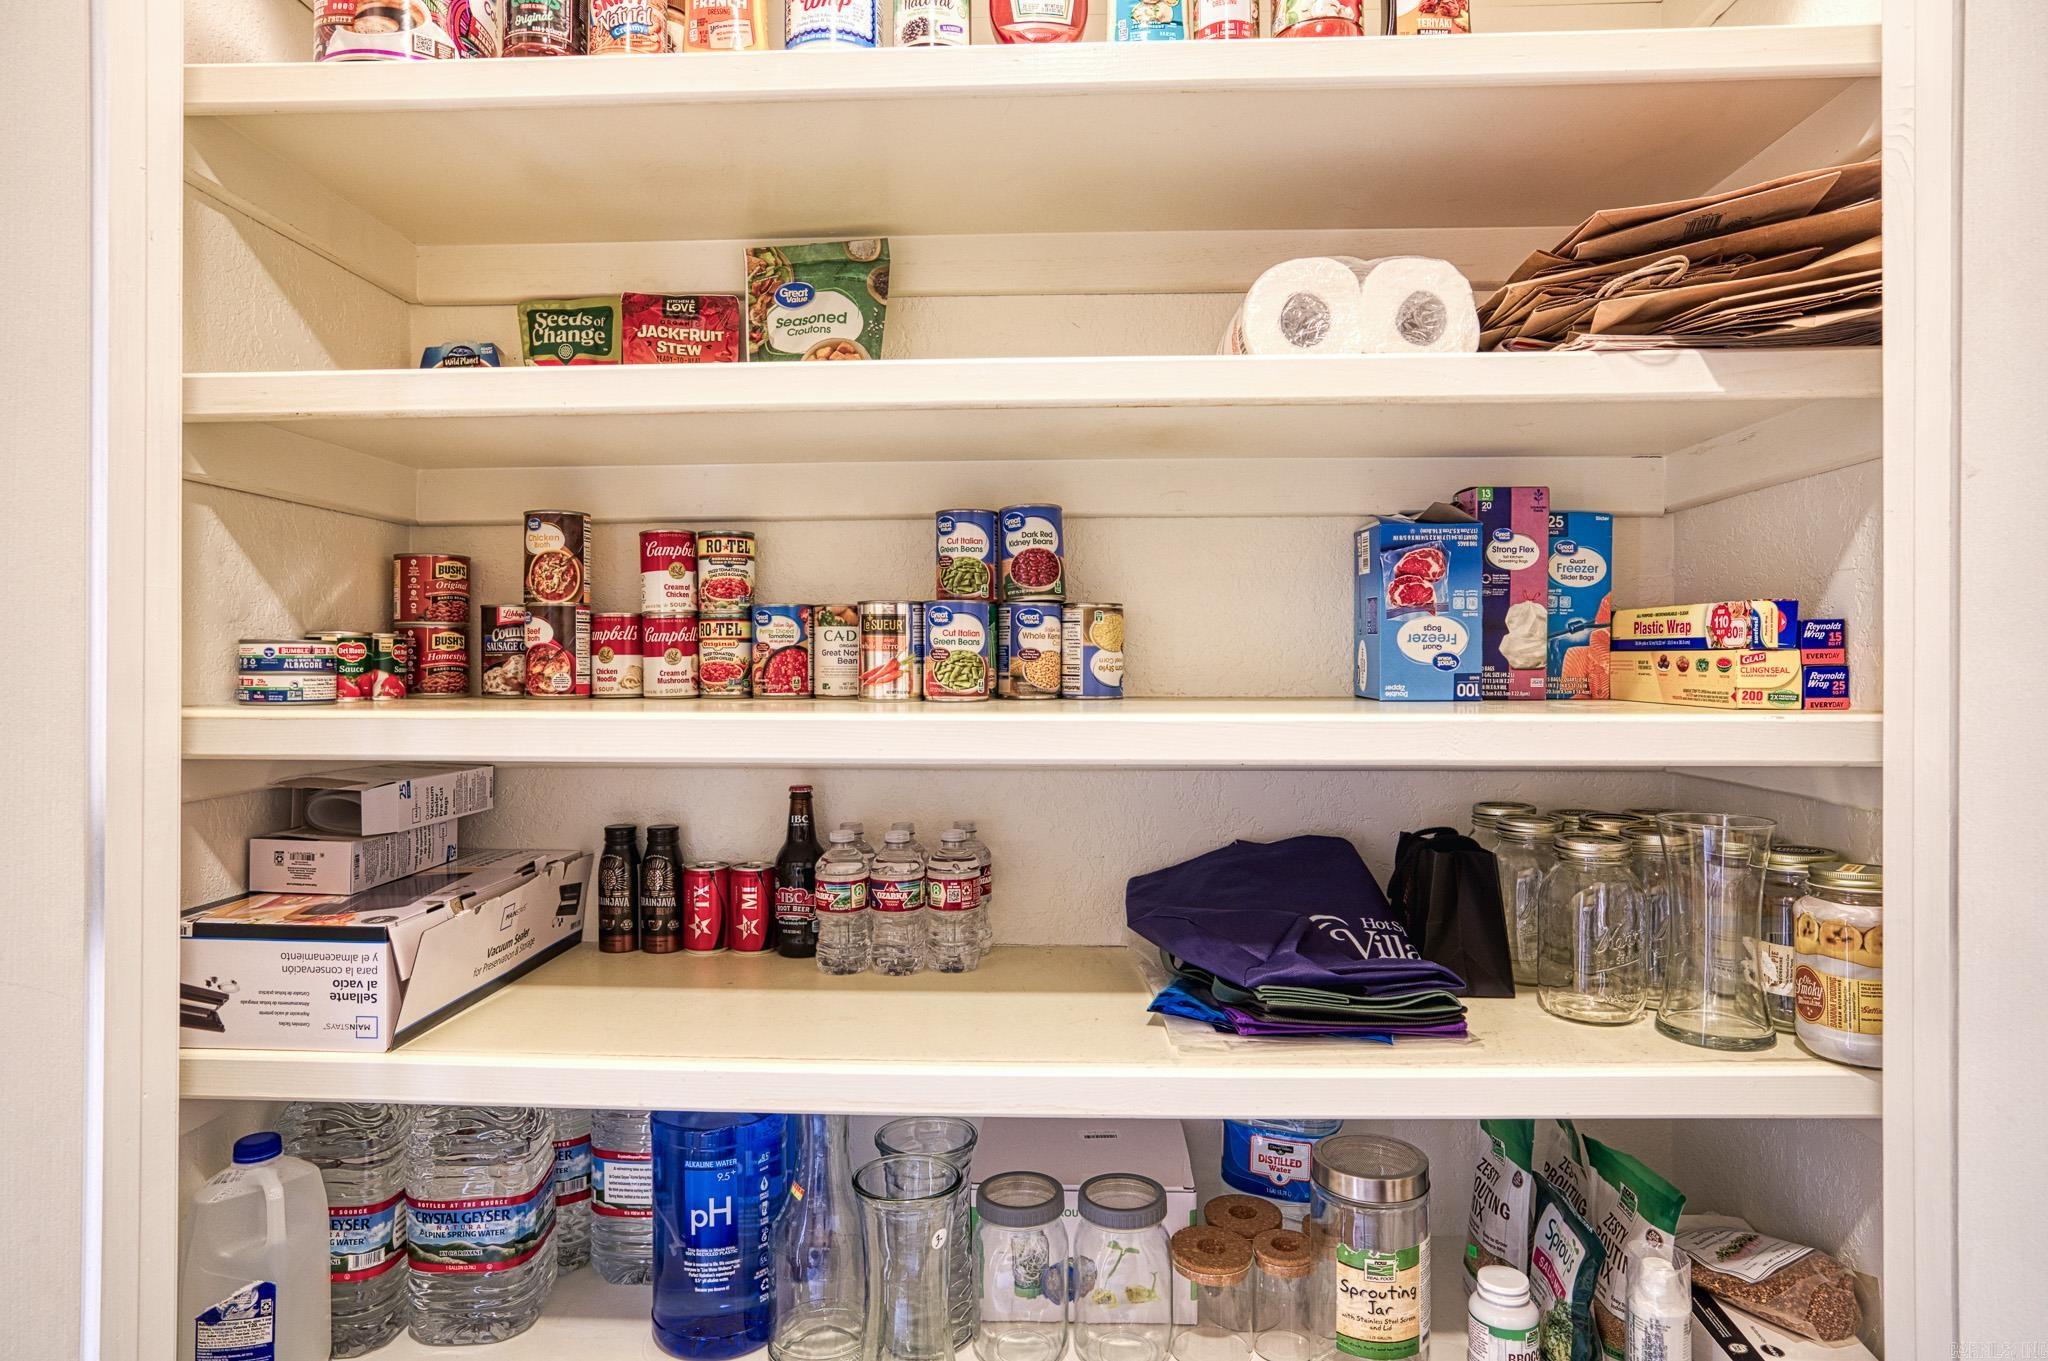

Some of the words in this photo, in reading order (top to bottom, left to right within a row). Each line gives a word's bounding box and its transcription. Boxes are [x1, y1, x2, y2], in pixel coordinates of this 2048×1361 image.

[514, 10, 554, 26] Original
[599, 6, 653, 33] Natural
[1417, 18, 1452, 28] TERIYAKI
[779, 288, 809, 299] Great
[786, 295, 808, 303] Value
[666, 303, 696, 313] LOVE
[535, 312, 592, 330] Seeds
[594, 316, 606, 327] of
[776, 312, 848, 329] Seasoned
[637, 324, 725, 342] JACKFRUIT
[787, 325, 831, 337] Croutons
[533, 328, 606, 346] Change
[657, 341, 702, 356] STEW
[444, 357, 460, 366] Wild
[460, 356, 480, 365] Planet
[1482, 489, 1491, 498] 13
[1481, 502, 1492, 510] 20
[1004, 518, 1021, 526] Great
[1548, 516, 1564, 528] 25
[528, 534, 560, 542] Chicken
[960, 537, 983, 545] Italian
[1009, 539, 1030, 547] Kidney
[727, 540, 750, 554] TEL
[1492, 546, 1517, 554] Strong
[438, 565, 466, 577] BUSH'S
[1556, 563, 1599, 574] Freezer
[436, 581, 467, 590] Original
[931, 611, 948, 619] Great
[1019, 612, 1039, 620] Great
[1714, 616, 1729, 629] 110
[1806, 622, 1842, 630] Reynolds
[527, 627, 541, 635] Beef
[716, 623, 742, 637] TEL
[1423, 625, 1441, 633] Bags
[1633, 621, 1664, 634] Plastic
[1667, 620, 1691, 636] Wrap
[1022, 632, 1045, 640] Whole
[1407, 633, 1457, 644] Freezer
[1804, 630, 1825, 639] Wrap
[1828, 632, 1842, 641] 15
[434, 636, 464, 647] BUSH'S
[486, 642, 520, 651] SAUSAGE
[933, 638, 957, 646] Green
[958, 638, 980, 646] Beans
[428, 652, 467, 662] Homestyle
[1742, 654, 1765, 664] GLAD
[339, 665, 364, 673] Sauce
[1810, 672, 1845, 680] Reynolds
[1385, 684, 1405, 692] Zipper
[1807, 679, 1829, 689] Wrap
[1832, 681, 1845, 690] 25
[1456, 683, 1480, 697] 100
[1742, 691, 1763, 701] 200
[399, 783, 407, 799] 25
[791, 815, 809, 824] IBC
[693, 884, 710, 911] TX
[781, 892, 803, 903] IBC
[877, 892, 908, 900] OZARKA
[777, 905, 792, 913] ROOT
[793, 905, 810, 913] BEER
[1360, 918, 1392, 931] Hot
[487, 939, 513, 958] Vacuum
[514, 928, 530, 945] Sealer
[1330, 928, 1421, 960] Villa
[280, 952, 358, 963] almacenamiento
[361, 954, 370, 963] el
[372, 953, 378, 962] y
[473, 967, 482, 978] for
[482, 950, 515, 973] Preservation
[514, 948, 519, 957] &
[519, 937, 536, 953] Storage
[1771, 951, 1779, 963] PIE
[282, 966, 342, 976] conservación
[345, 967, 354, 976] la
[357, 966, 378, 976] para
[333, 980, 363, 991] vacío
[367, 980, 378, 991] al
[1796, 978, 1823, 999] Smoky
[1829, 977, 1837, 1002] PUDDING
[329, 992, 378, 1004] Sellante
[1829, 1003, 1837, 1028] BANANA
[326, 1023, 370, 1032] MAINSTAYS
[685, 1160, 714, 1168] ALKALINE
[716, 1159, 737, 1167] WATER
[1258, 1154, 1302, 1168] DISTILLED
[1269, 1165, 1291, 1174] Water
[1476, 1157, 1501, 1187] ZESTY
[1474, 1176, 1511, 1221] OUTING
[415, 1211, 459, 1224] CRYSTAL
[462, 1209, 510, 1224] GEYSER
[691, 1196, 732, 1235] pH
[1602, 1212, 1629, 1244] ZESTY
[420, 1229, 446, 1239] ALPINE
[447, 1230, 476, 1238] SPRING
[478, 1229, 505, 1237] WATER
[1340, 1279, 1417, 1300] Sprouting
[1368, 1300, 1394, 1316] Jar
[1356, 1315, 1382, 1325] Stainless
[1400, 1315, 1416, 1323] Screen
